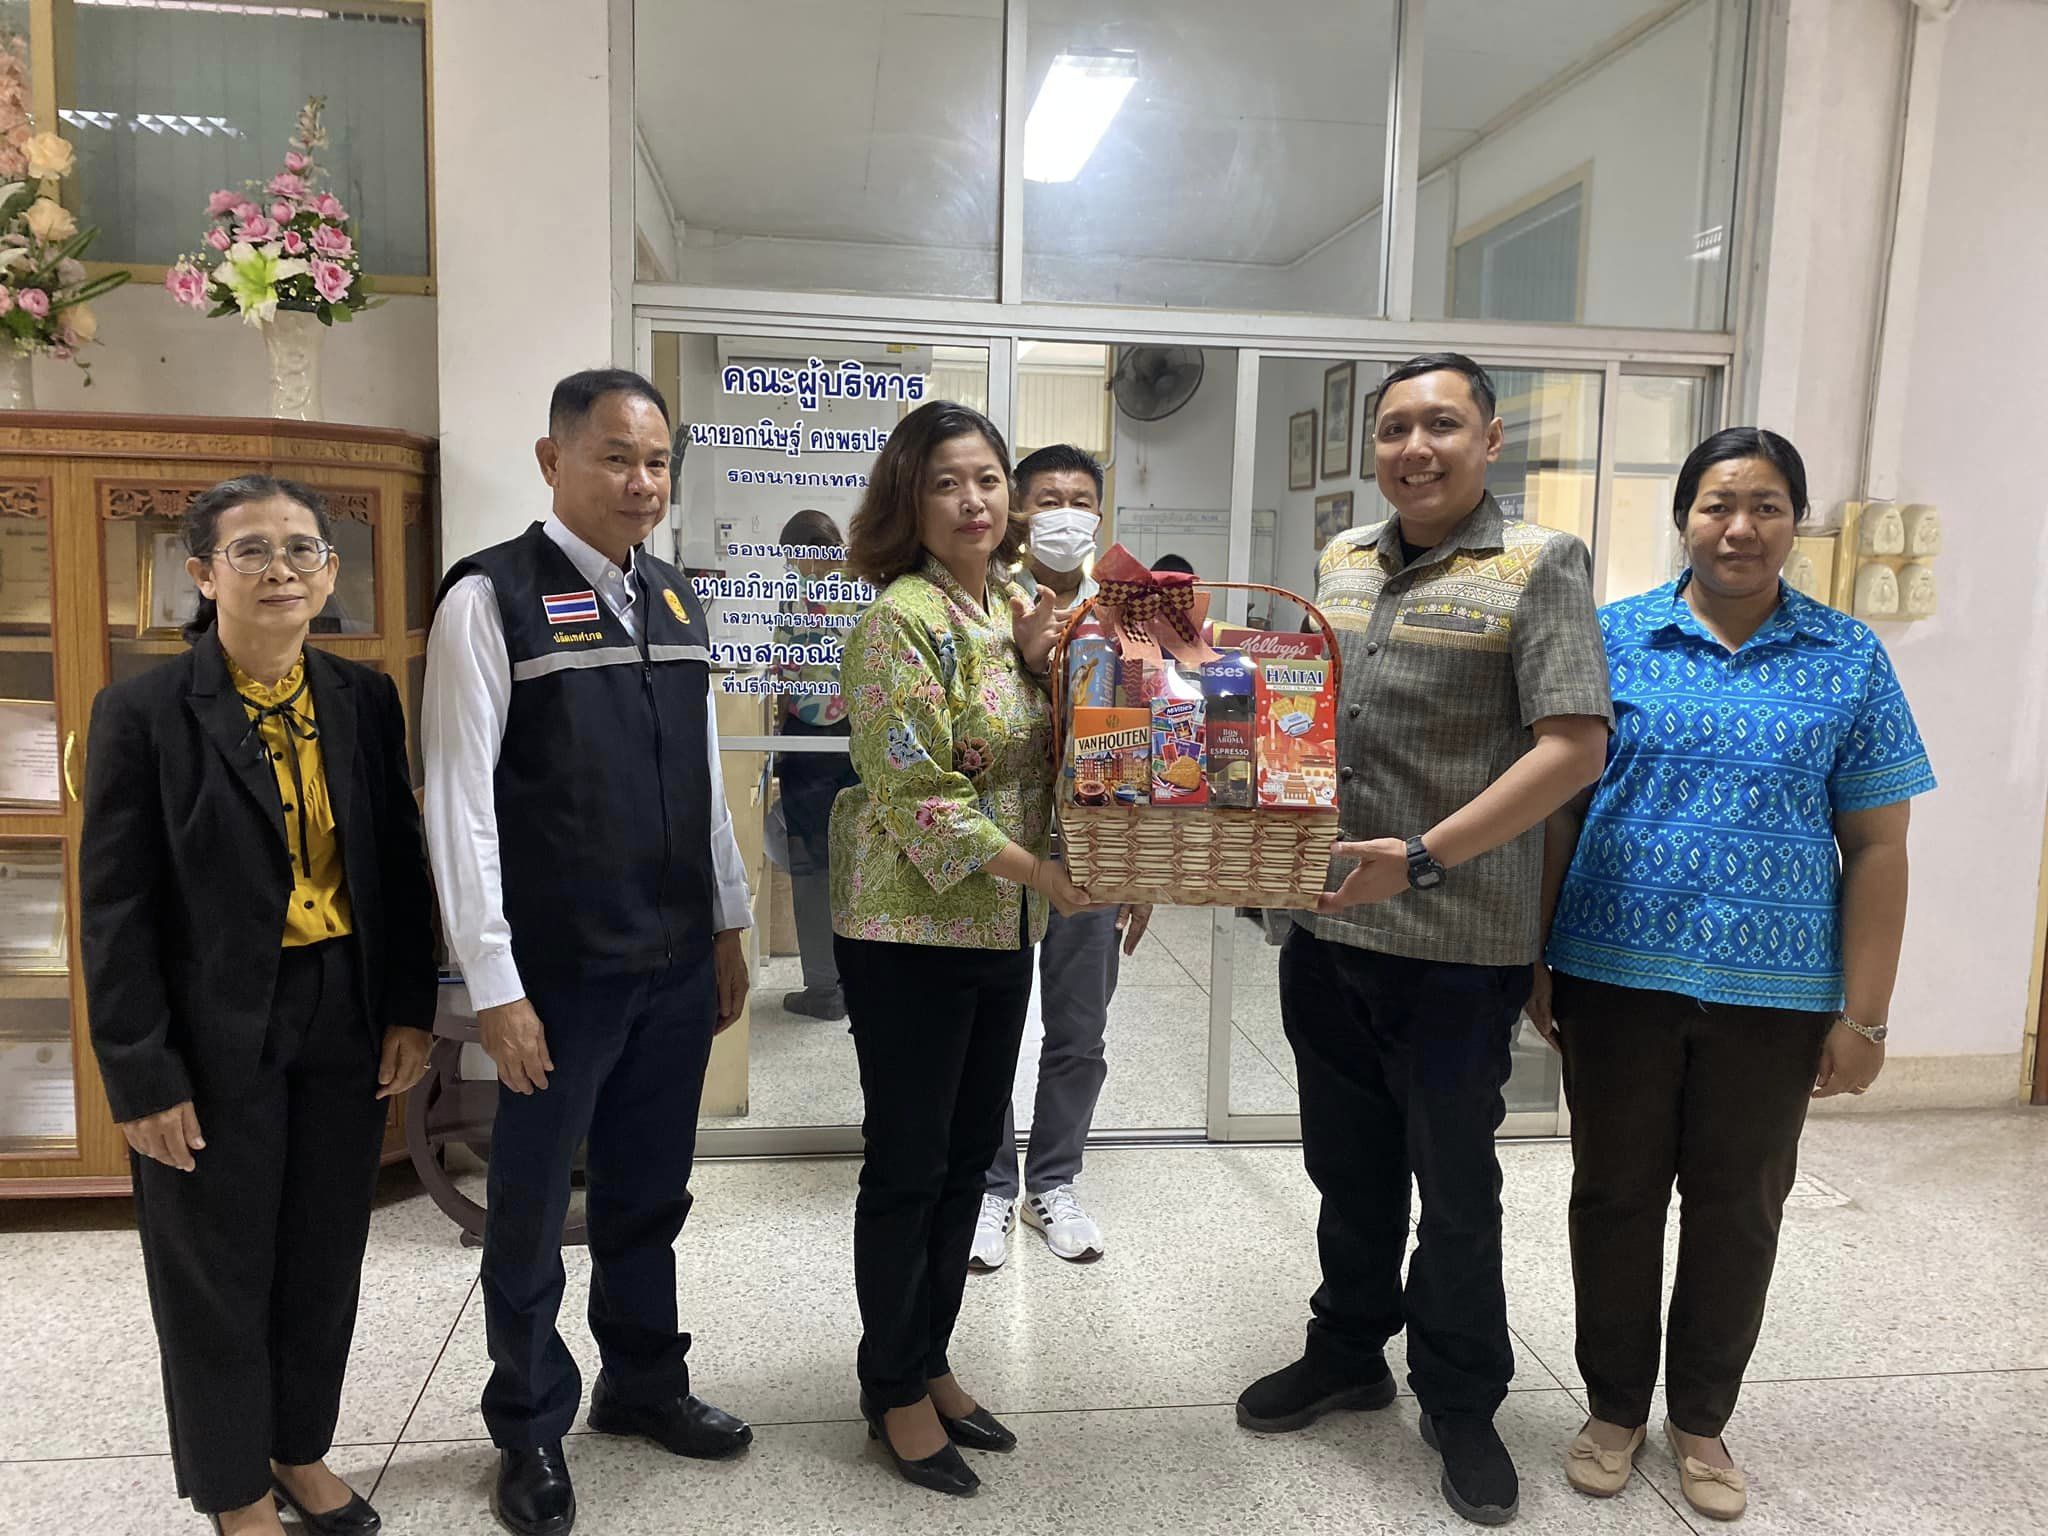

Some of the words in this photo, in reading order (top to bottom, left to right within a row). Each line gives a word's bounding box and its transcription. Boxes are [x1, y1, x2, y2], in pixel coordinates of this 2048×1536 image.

[724, 358, 924, 409] คณะผู้บริหาร
[692, 420, 802, 455] นายอกนิษฐ์
[811, 428, 887, 451] คงพรปร
[728, 469, 869, 488] รองนายกเทศม
[693, 572, 798, 599] นายอภิชาติ
[807, 573, 881, 600] เครือเข
[1240, 635, 1308, 659] Kellogg's
[722, 671, 839, 694] ที่ปรึกษานายก
[1266, 669, 1323, 685] HAITAI
[1078, 737, 1099, 751] VAN
[1099, 728, 1148, 750] HOUTEN
[1210, 747, 1249, 756] ESPRESSO
